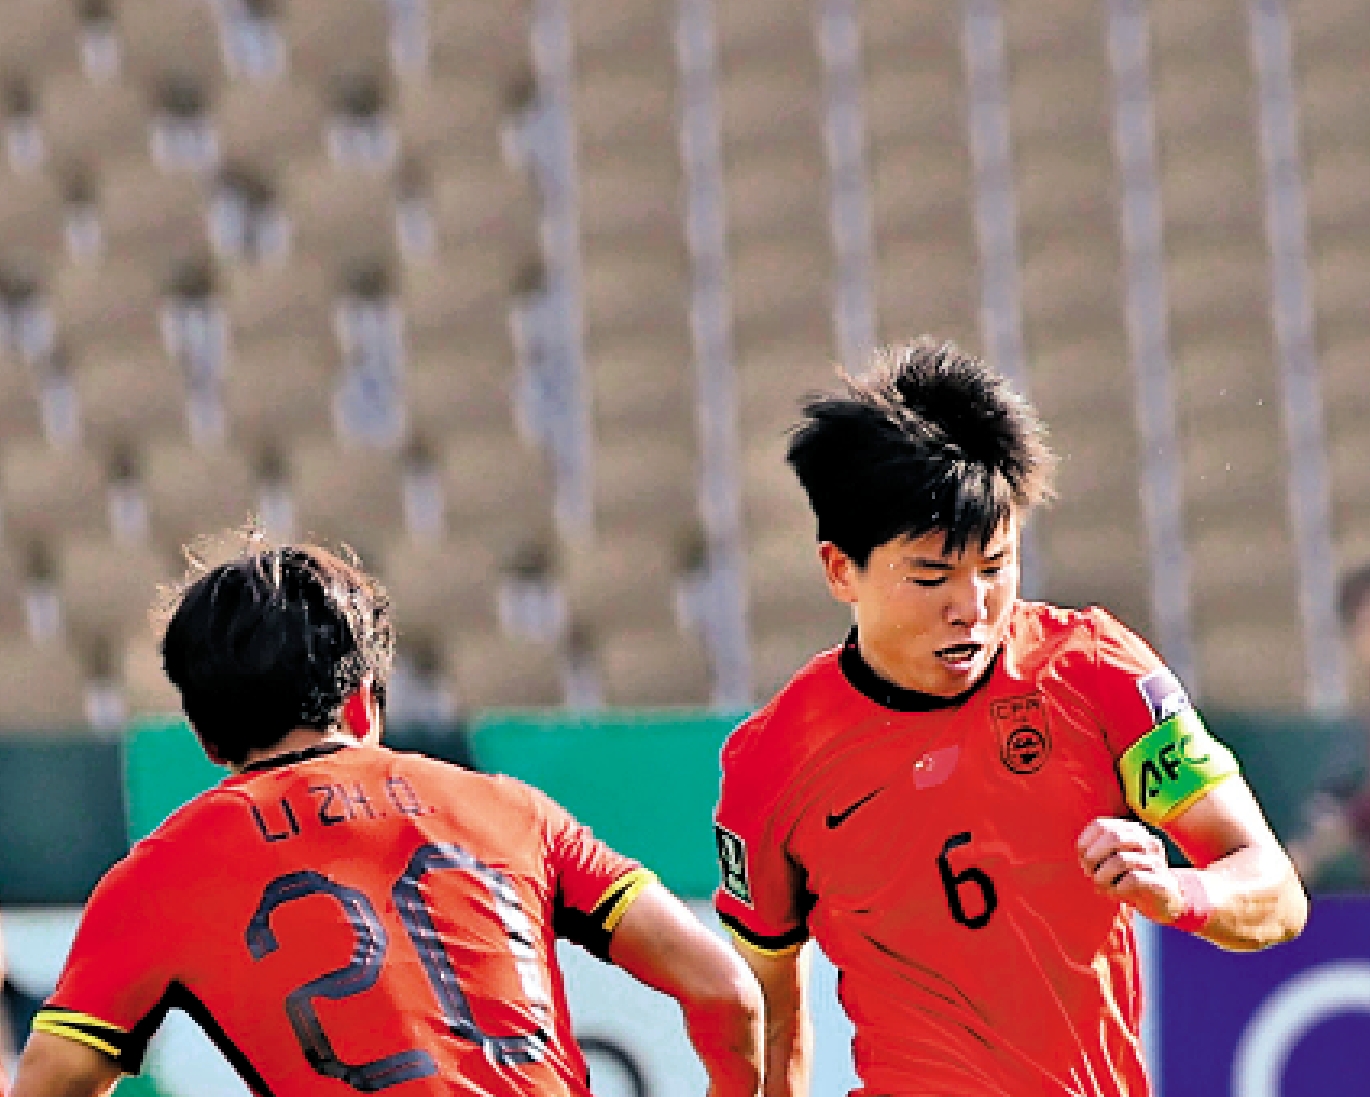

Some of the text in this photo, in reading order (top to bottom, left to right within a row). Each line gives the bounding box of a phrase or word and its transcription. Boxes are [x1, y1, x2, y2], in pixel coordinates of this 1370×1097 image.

[1140, 734, 1211, 810] AFC
[251, 797, 302, 843] LI
[938, 831, 998, 930] 6
[244, 841, 556, 1094] 20
